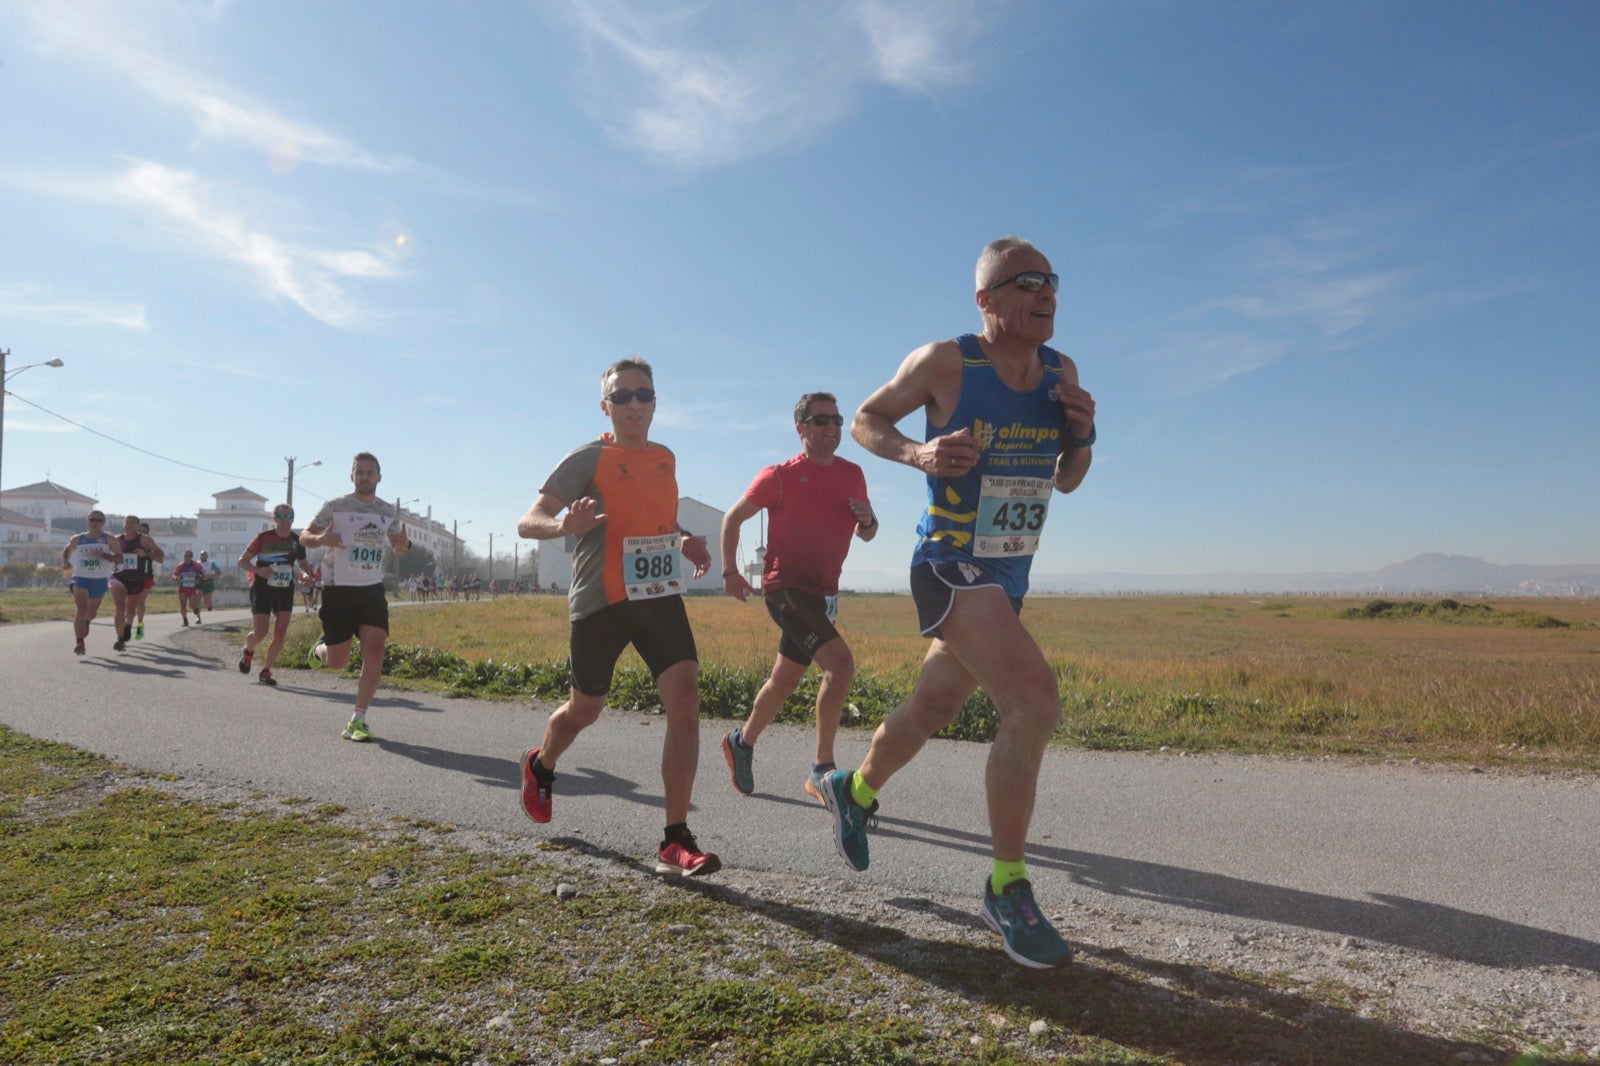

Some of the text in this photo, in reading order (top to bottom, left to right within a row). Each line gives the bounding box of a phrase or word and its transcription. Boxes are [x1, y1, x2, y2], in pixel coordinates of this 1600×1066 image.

[998, 422, 1060, 444] olimpo
[994, 441, 1034, 452] deportes
[988, 457, 1011, 466] TRAIL
[1013, 457, 1019, 466] &
[992, 502, 1046, 531] 433
[351, 547, 383, 562] 1016
[83, 558, 101, 568] 905
[634, 553, 673, 580] 988
[273, 571, 290, 581] 582
